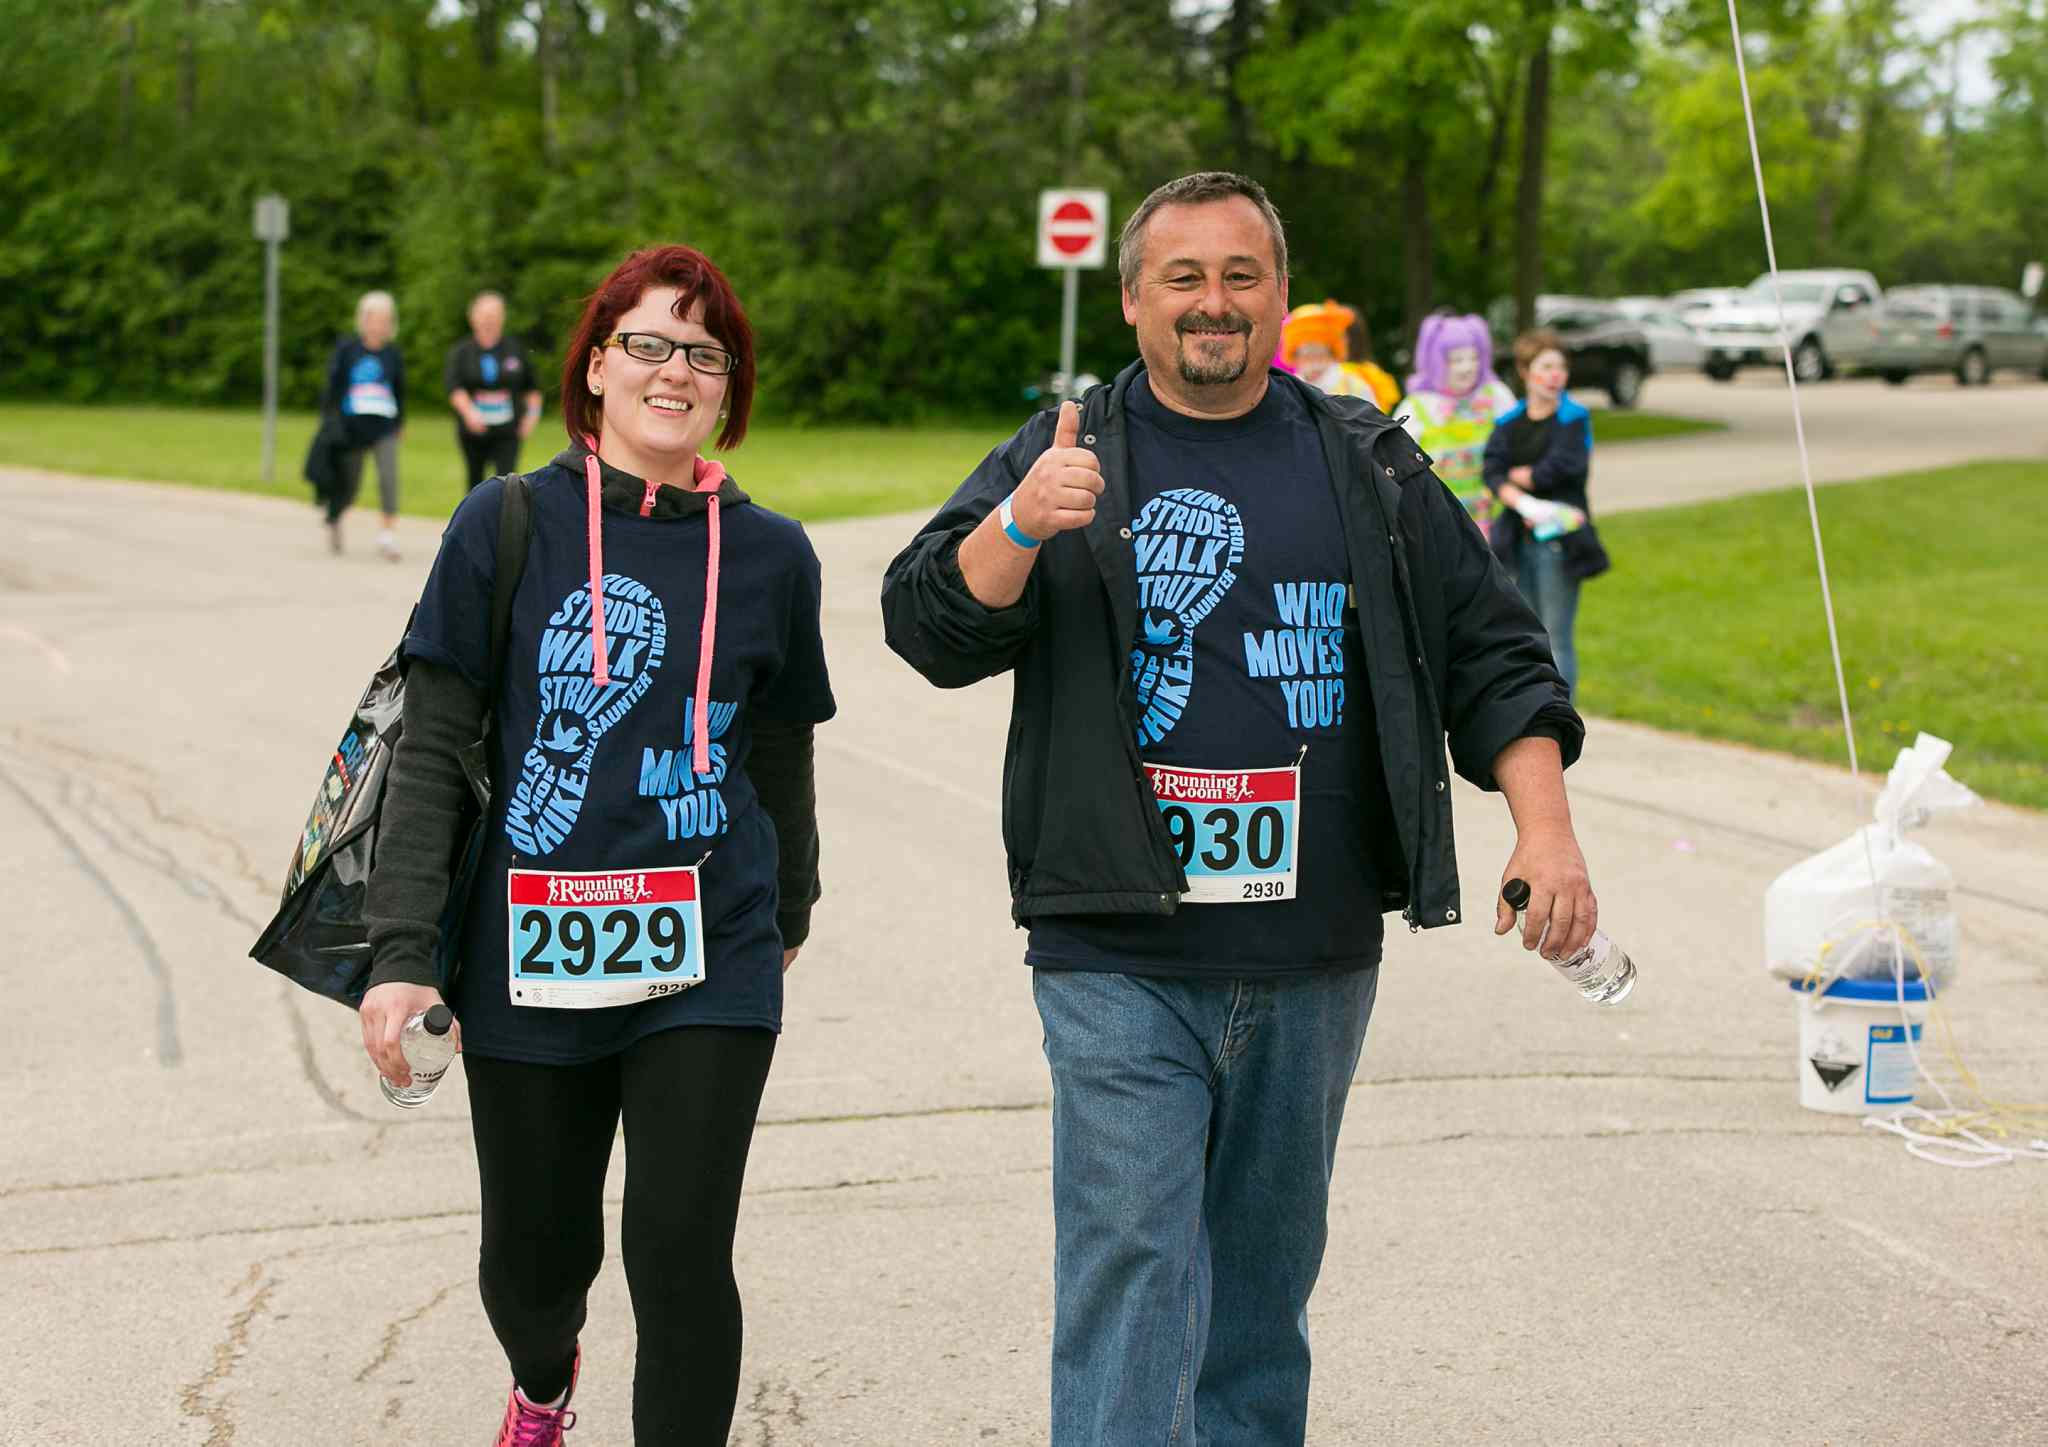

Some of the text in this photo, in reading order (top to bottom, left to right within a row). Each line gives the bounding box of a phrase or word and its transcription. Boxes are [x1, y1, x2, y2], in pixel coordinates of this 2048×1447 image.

[1132, 497, 1230, 539] STRIDE
[1160, 488, 1225, 512] RUN
[1224, 503, 1245, 568] STROLL
[584, 573, 652, 604] RUN
[1138, 575, 1214, 614] TRUT
[1179, 568, 1237, 629] SAUNTER
[1273, 582, 1346, 628] WHO
[645, 597, 666, 670] STROLL
[1244, 628, 1345, 678] MOVES
[540, 676, 629, 720] STRUT
[586, 671, 653, 739] SAUNTER
[1142, 658, 1193, 743] HIKE
[1281, 679, 1345, 729] YOU?
[531, 764, 555, 815] HOP
[1164, 773, 1238, 799] Running
[533, 768, 588, 855] HIKE
[1161, 805, 1284, 871] 930
[559, 874, 635, 903] Running
[1243, 881, 1285, 899] 2930
[519, 907, 687, 976] 2929
[648, 983, 690, 997] 2929
